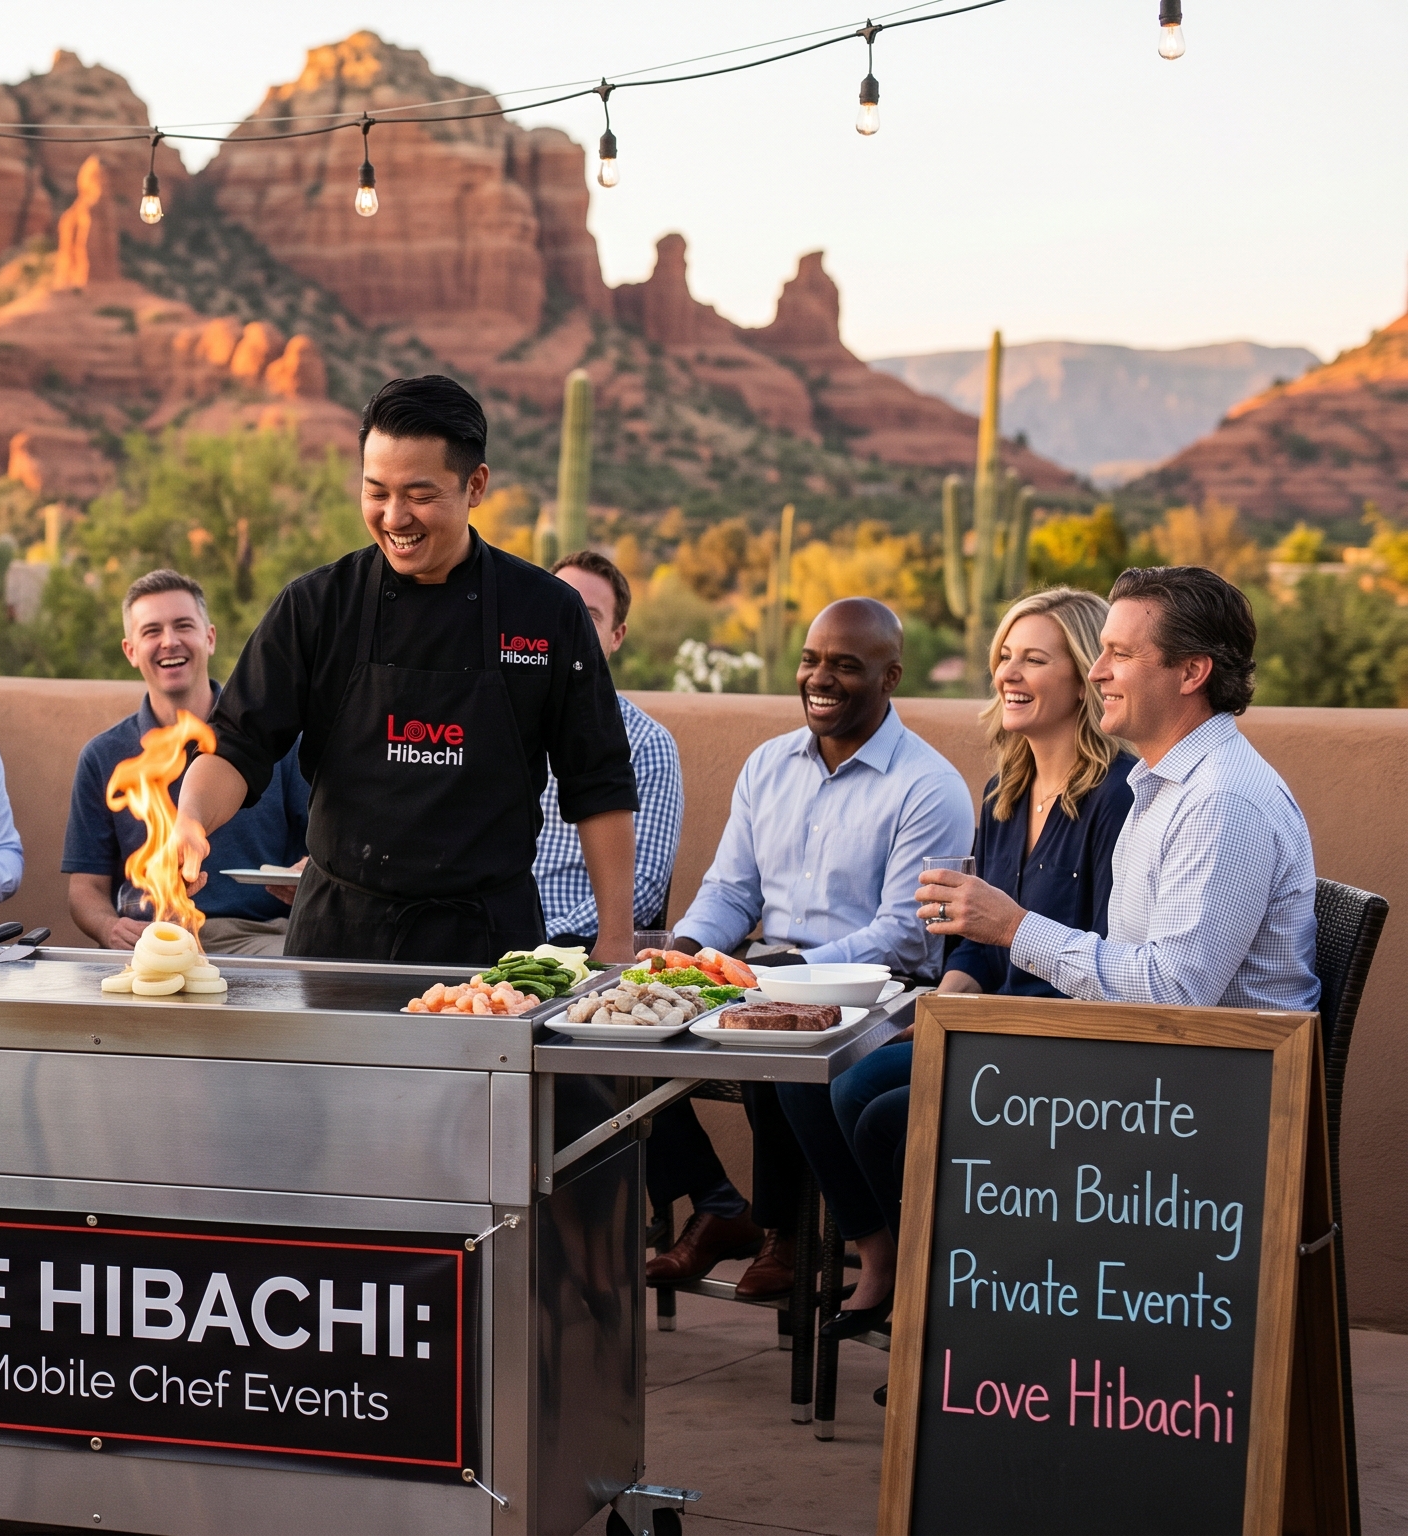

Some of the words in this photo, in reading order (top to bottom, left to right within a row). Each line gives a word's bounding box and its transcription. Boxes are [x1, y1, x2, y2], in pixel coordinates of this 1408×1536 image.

[500, 633, 549, 652] Love
[500, 650, 549, 666] Hibachi
[387, 714, 464, 745] Love
[387, 743, 464, 766] Hibachi
[970, 1063, 1198, 1150] Corporate
[951, 1158, 1058, 1222] Team
[1075, 1164, 1244, 1262] Building
[40, 1260, 430, 1360] HIBACHI:
[949, 1248, 1079, 1317] Private
[1097, 1261, 1232, 1331] Events
[129, 1364, 232, 1408] Chef
[245, 1372, 389, 1421] Events
[942, 1348, 1051, 1422] Love
[1069, 1358, 1234, 1444] Hibachi
